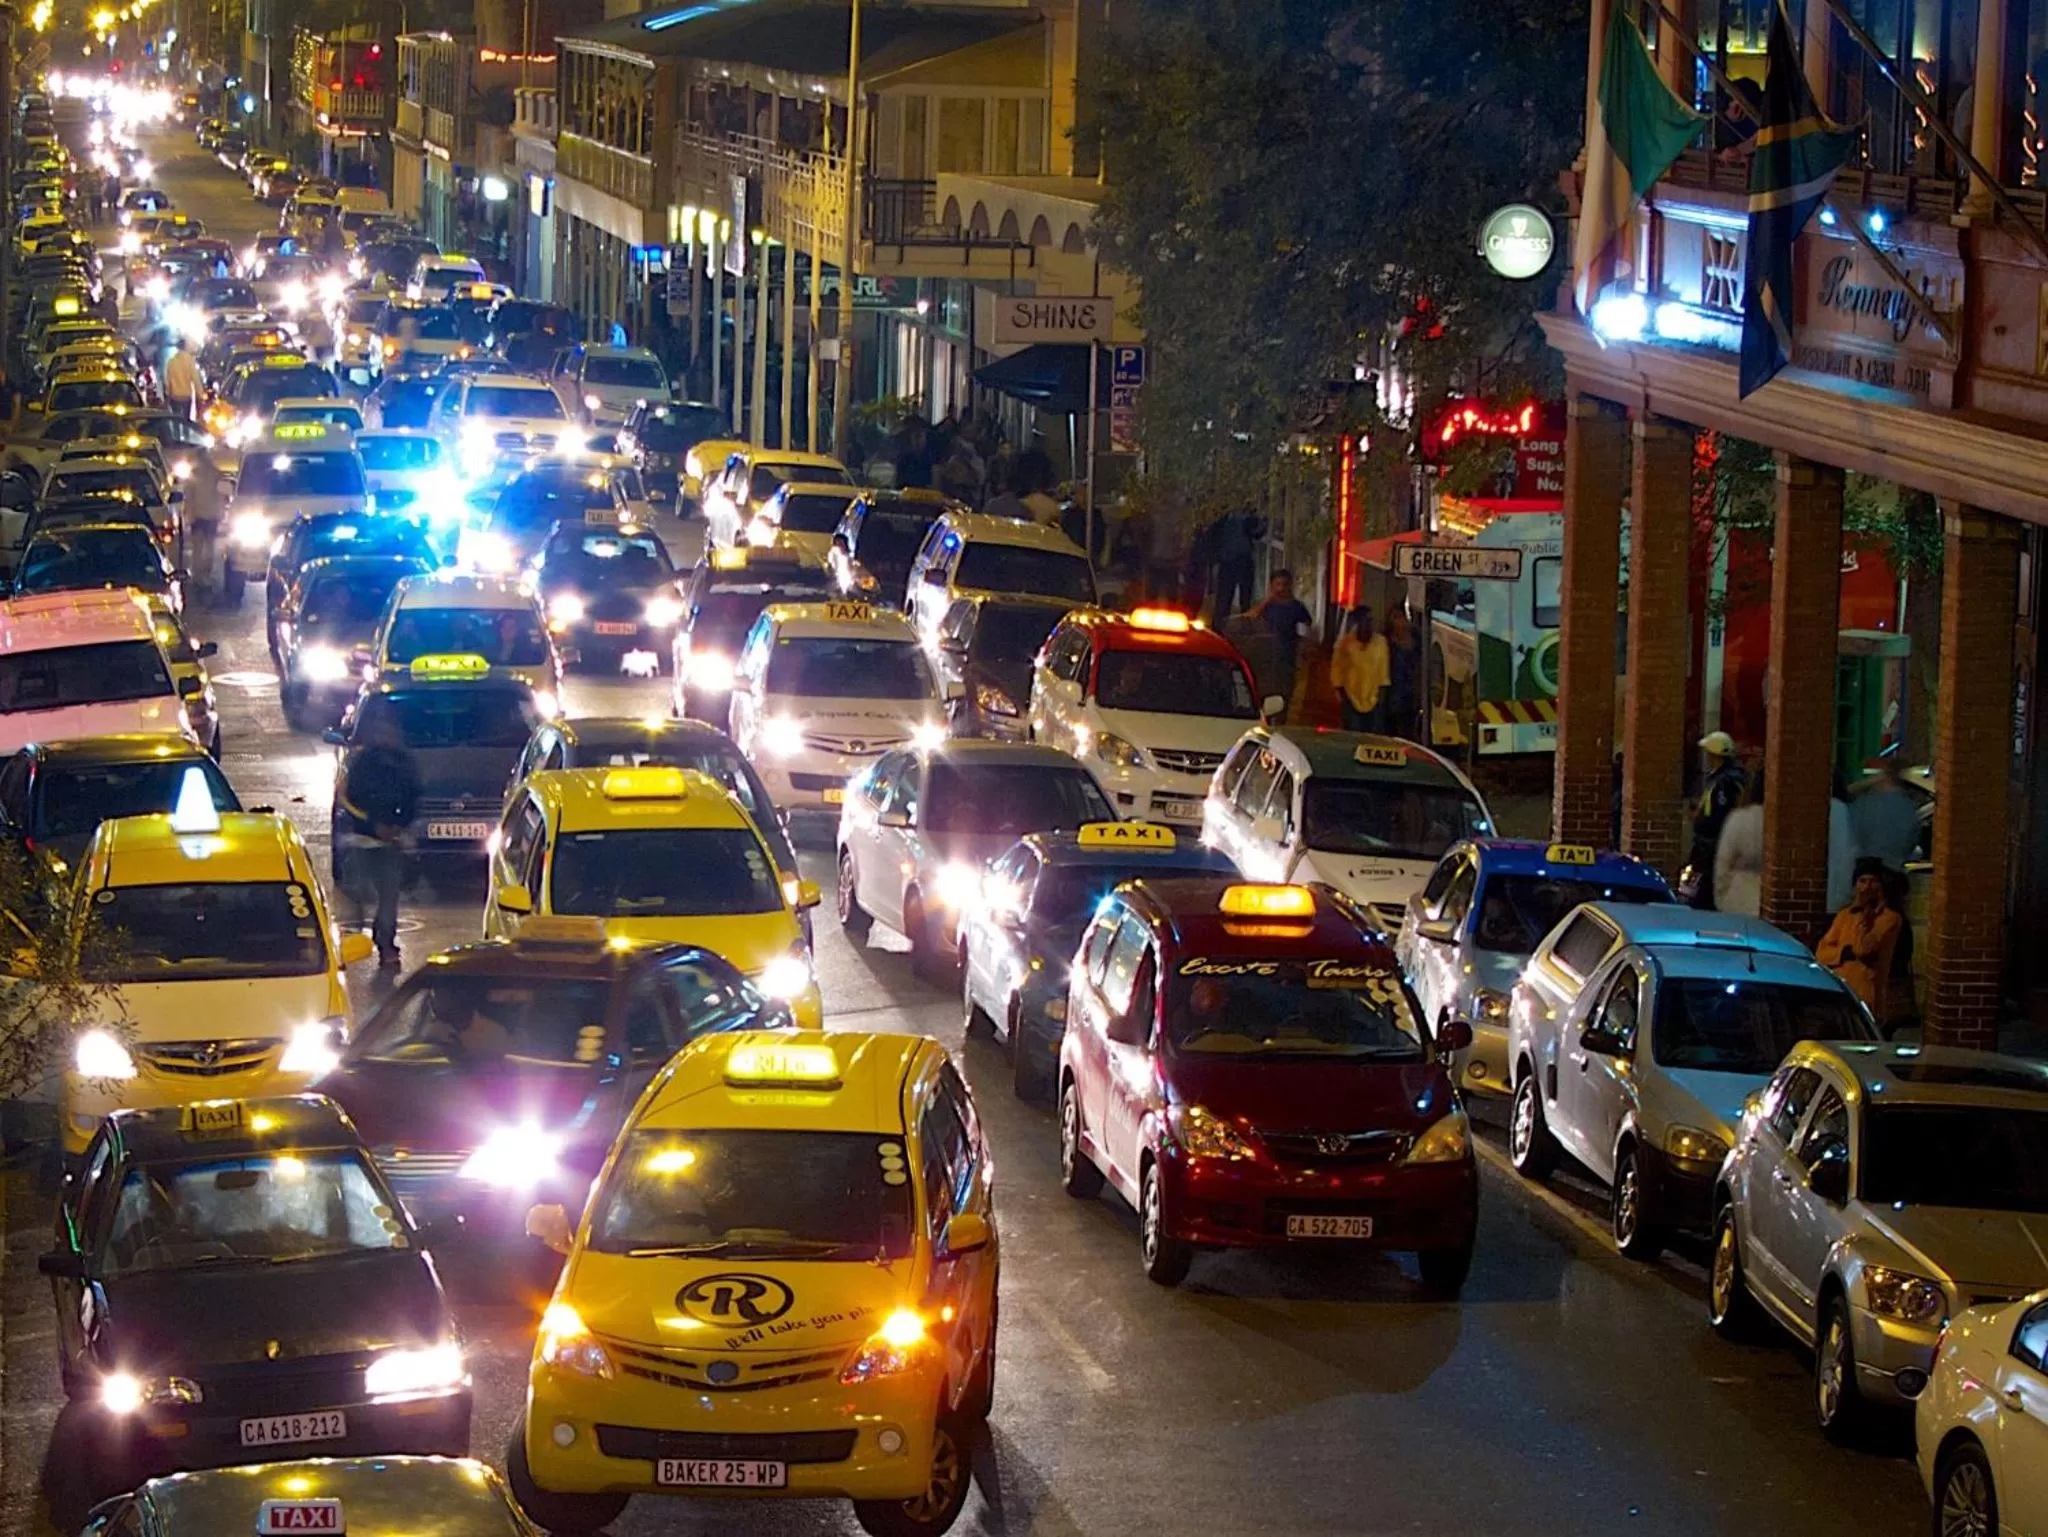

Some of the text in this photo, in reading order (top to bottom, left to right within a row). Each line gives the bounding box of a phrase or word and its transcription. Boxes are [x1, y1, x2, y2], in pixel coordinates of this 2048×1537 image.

[1011, 302, 1097, 330] SHINE
[1120, 349, 1136, 367] P
[1519, 439, 1559, 455] Long
[1412, 552, 1462, 572] GREEN
[827, 604, 869, 620] TAXI
[1365, 748, 1400, 761] TAXI
[1096, 827, 1163, 839] TAXI
[1306, 959, 1393, 978] Taxis
[200, 1109, 234, 1124] TAXI
[1288, 1217, 1369, 1236] CA 522-705
[768, 1319, 807, 1337] take
[810, 1312, 844, 1329] you
[244, 1414, 341, 1442] CA 618-212
[663, 1461, 720, 1483] BAKER
[273, 1507, 334, 1528] TAXI
